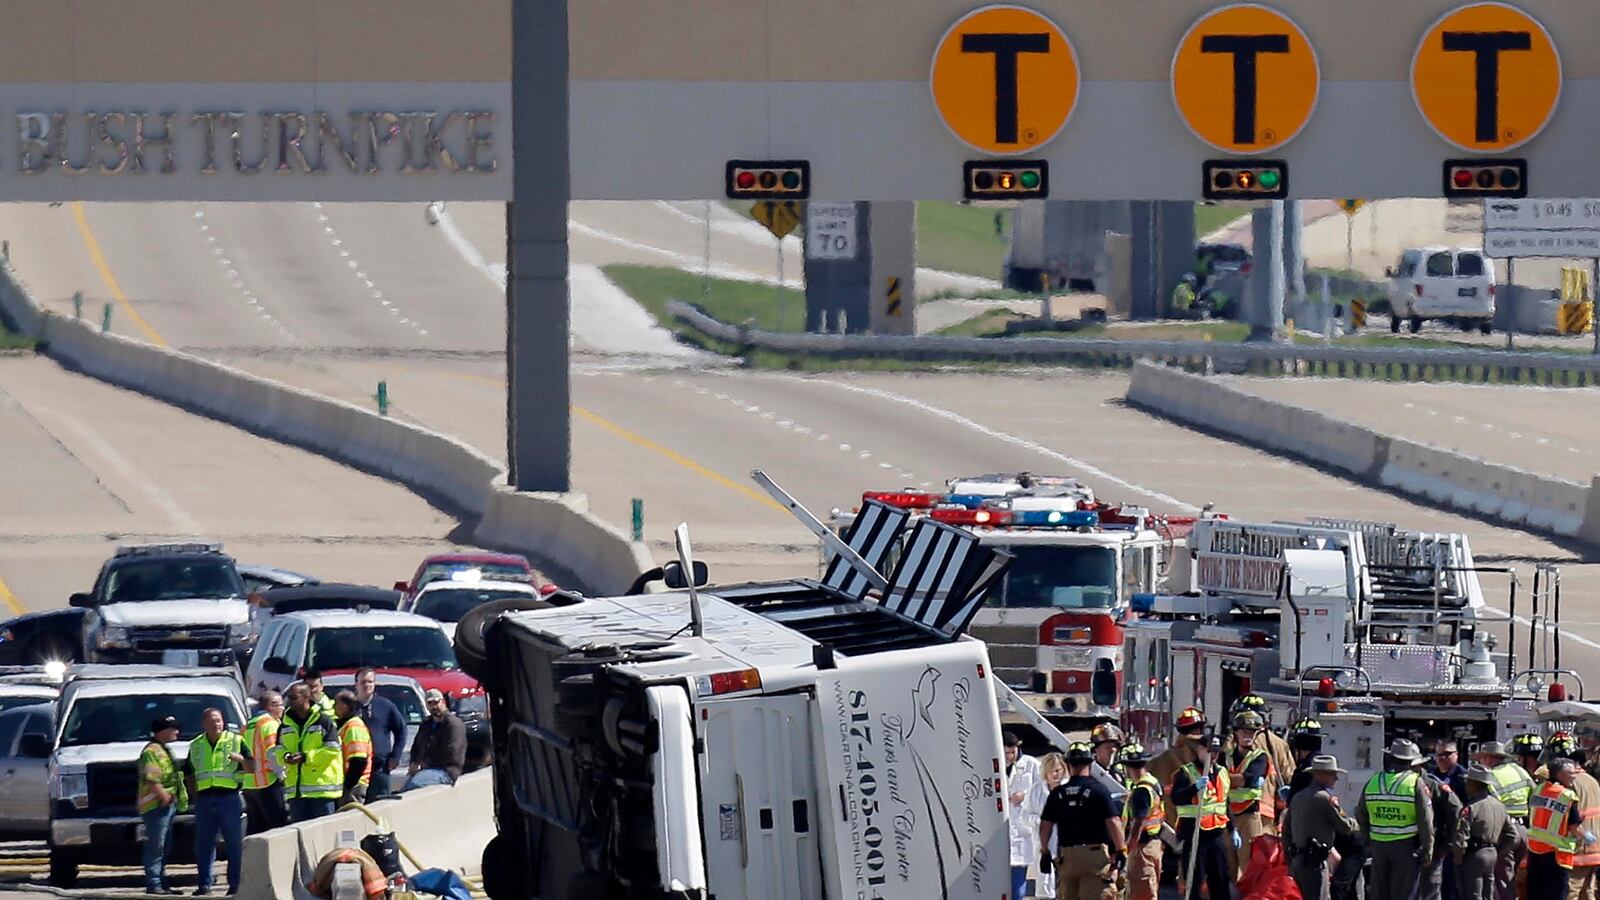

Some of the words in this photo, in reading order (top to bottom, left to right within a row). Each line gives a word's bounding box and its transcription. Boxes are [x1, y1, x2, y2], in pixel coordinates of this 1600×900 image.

[962, 33, 1050, 143] T
[1202, 34, 1290, 144] T
[1442, 31, 1532, 142] T
[15, 112, 177, 175] BUSH
[194, 112, 497, 175] TURNPIKE
[818, 234, 849, 251] 70
[880, 712, 906, 764] Tours
[953, 677, 974, 769] Cardinal
[887, 767, 907, 805] and
[963, 774, 981, 834] Coach
[983, 777, 993, 798] 702
[1376, 806, 1401, 814] STATE
[892, 808, 916, 883] Charter
[969, 841, 988, 894] Line
